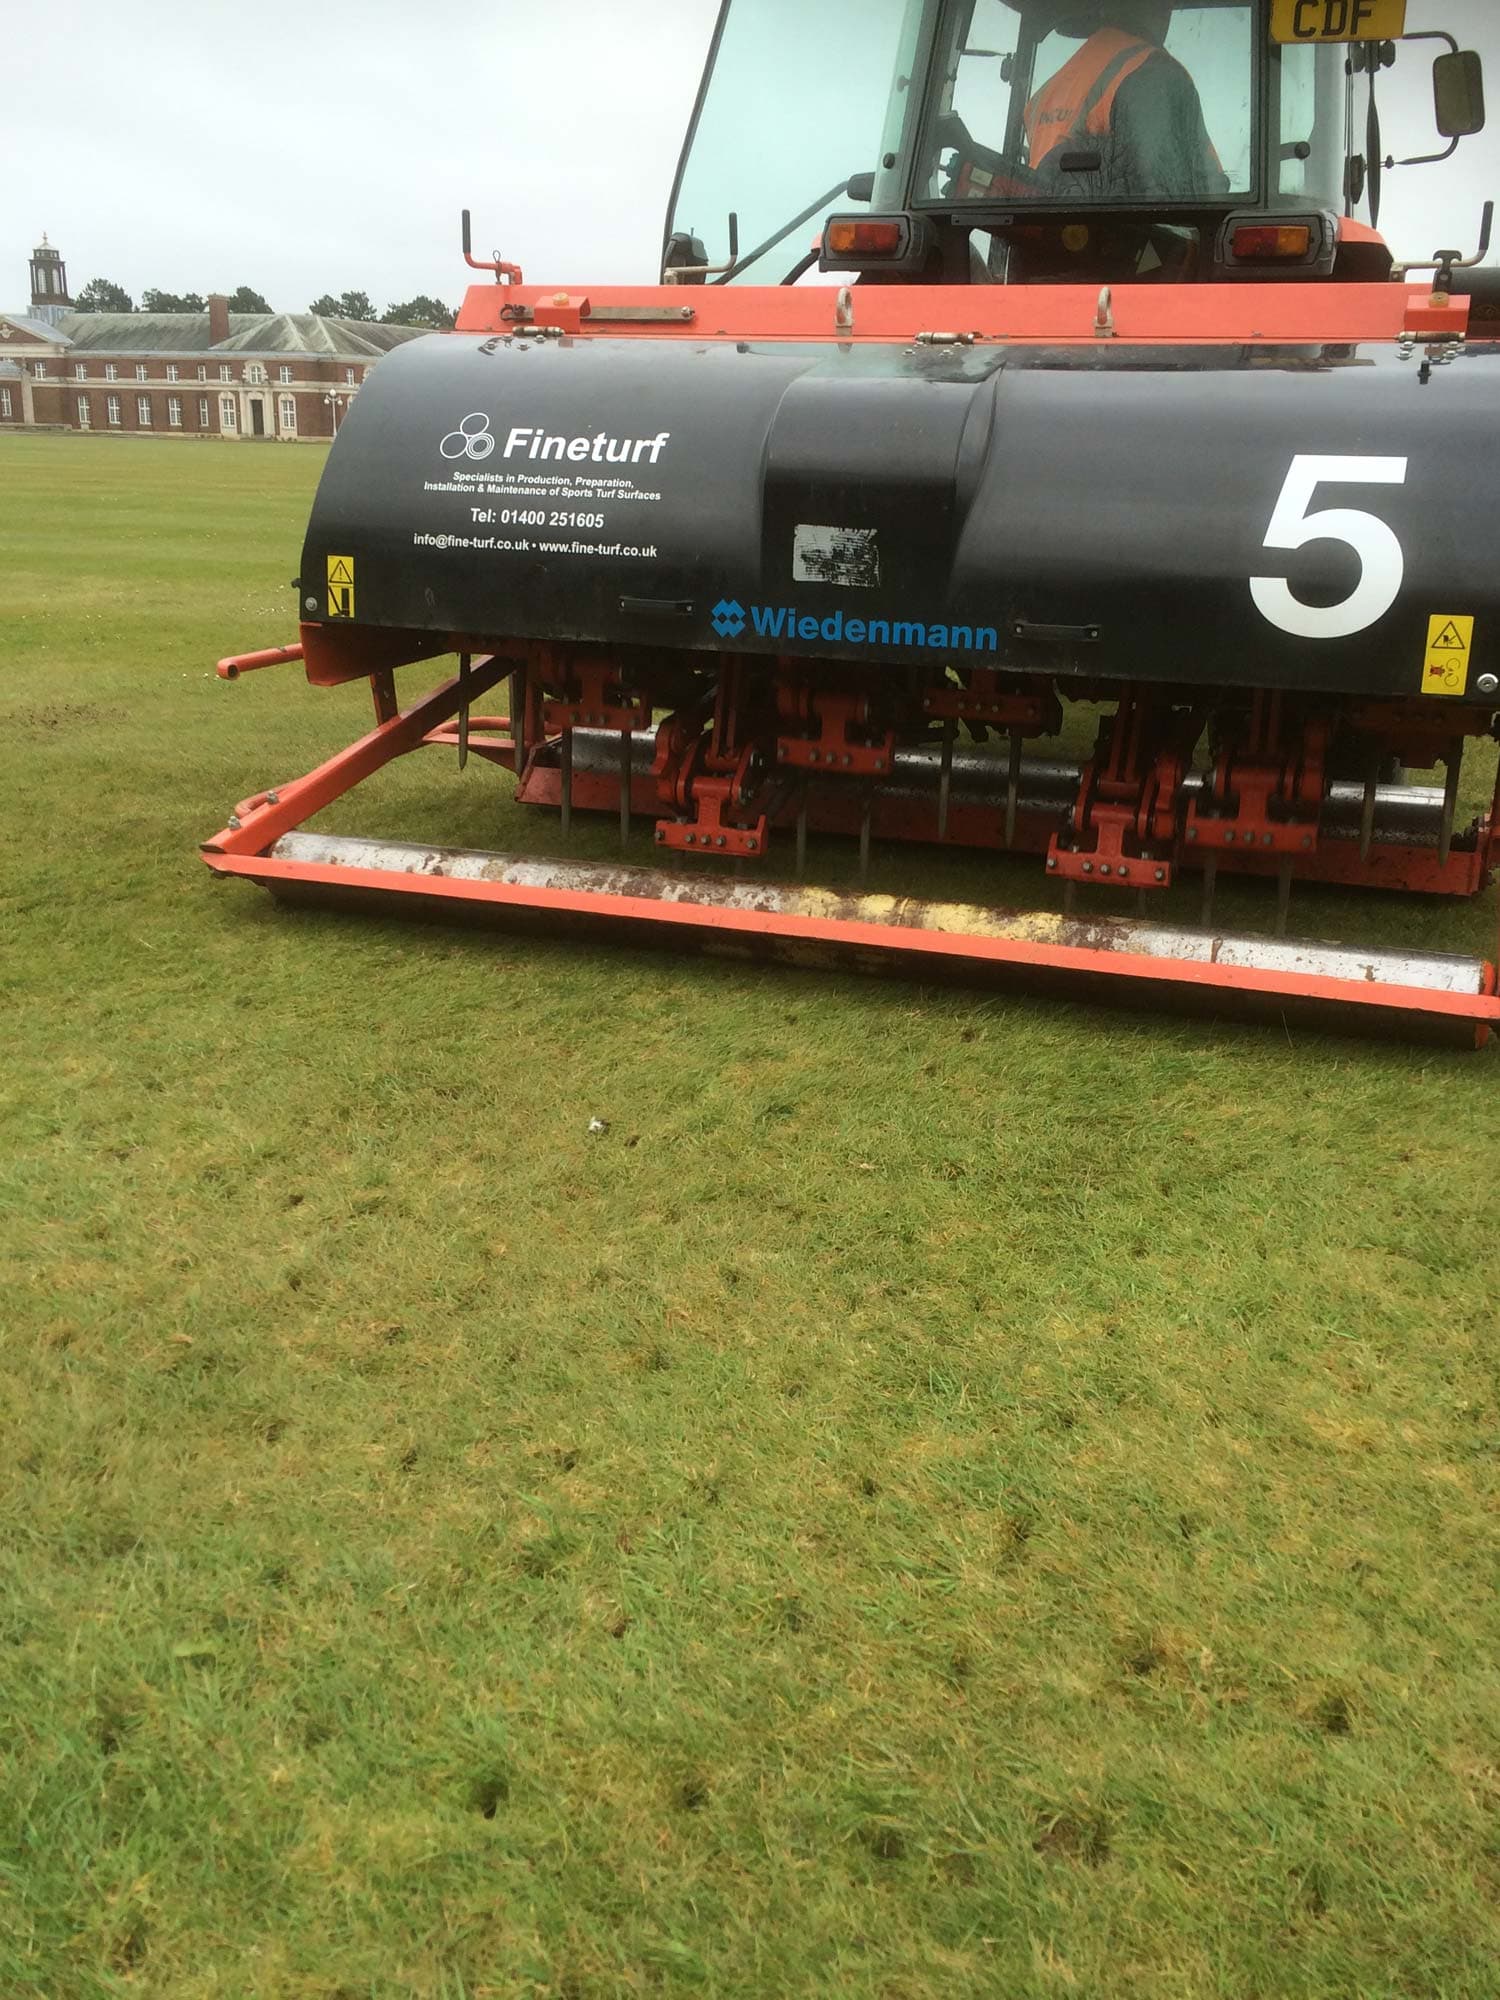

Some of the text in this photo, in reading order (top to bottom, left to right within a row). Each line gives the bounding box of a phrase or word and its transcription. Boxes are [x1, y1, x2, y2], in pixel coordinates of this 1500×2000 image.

[1293, 0, 1376, 38] CDF
[503, 428, 670, 464] Fineturf
[424, 481, 661, 500] Installation & Maintenance of Sports Turf Surfaces
[453, 471, 634, 488] Specialists in Production, Preparation,
[470, 508, 604, 528] Tel: 01400 251605
[413, 533, 657, 557] info@fine-turf.co.uk www.fine-turf.co.uk
[1249, 454, 1408, 638] 5
[750, 605, 998, 651] Wiedenmann
